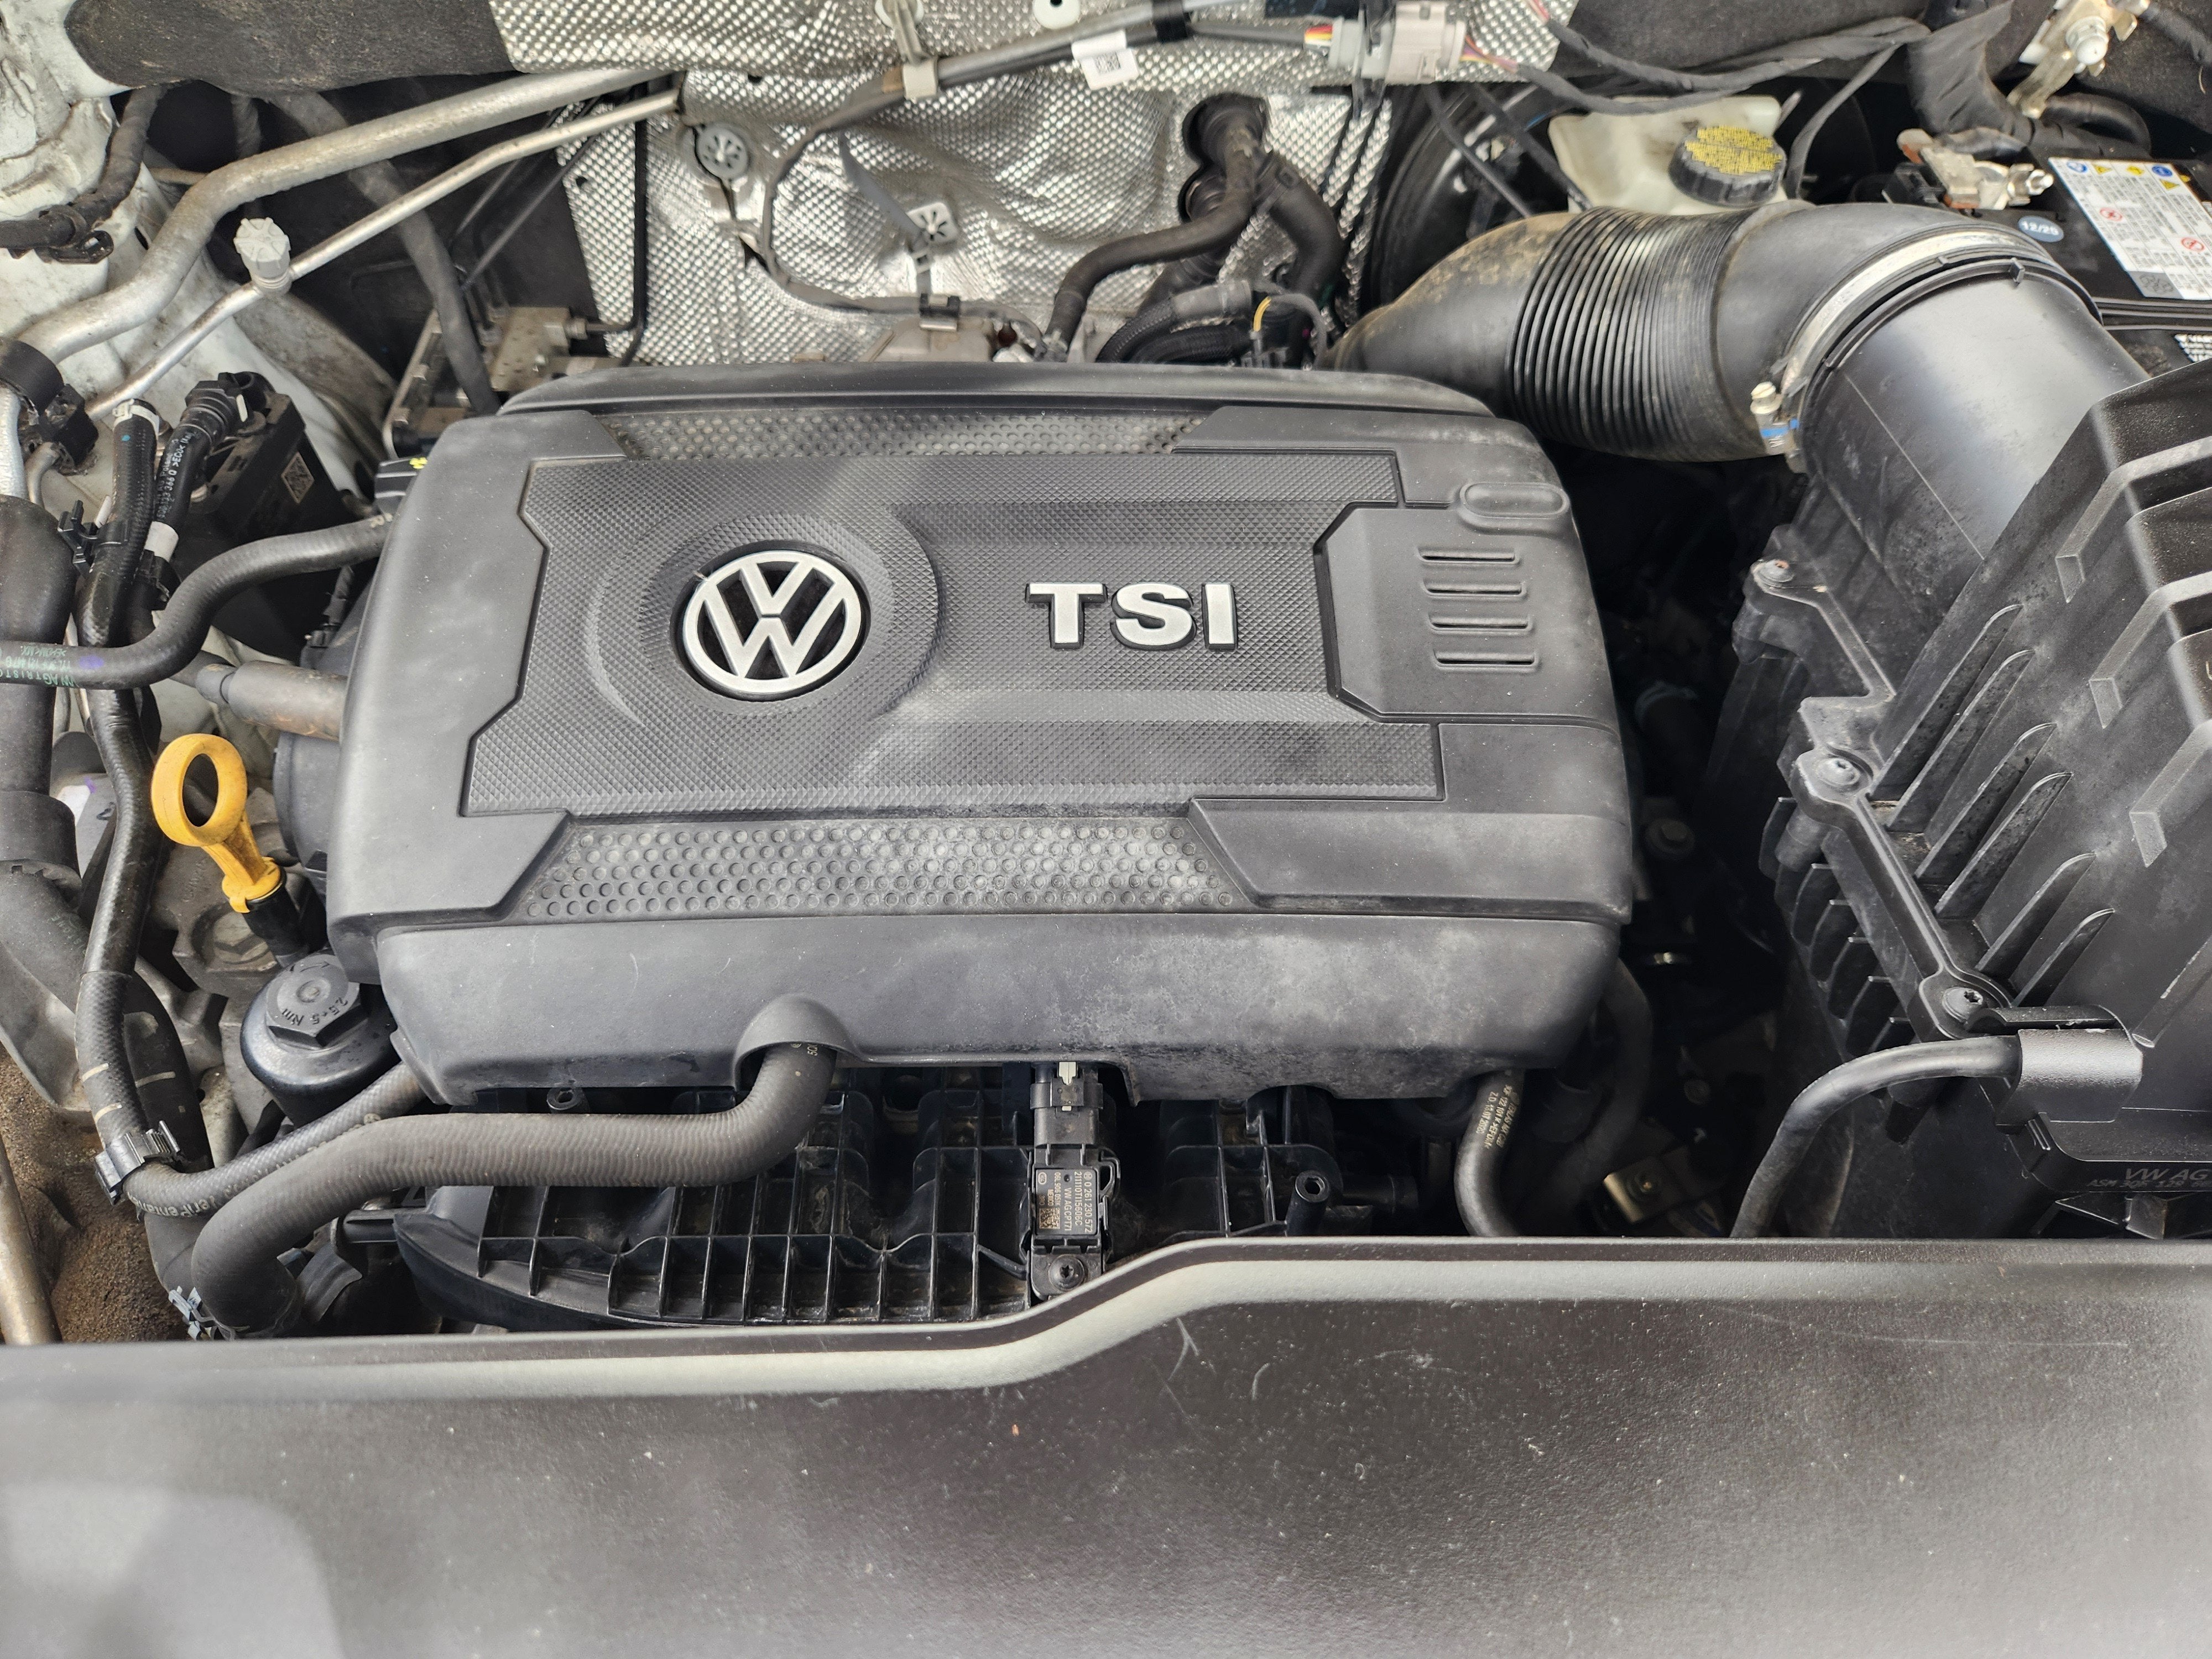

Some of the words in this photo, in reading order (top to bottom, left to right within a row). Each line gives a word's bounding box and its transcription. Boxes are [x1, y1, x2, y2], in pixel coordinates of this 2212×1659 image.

[682, 550, 862, 695] VW
[1026, 583, 1239, 650] TSI
[41, 672, 58, 685] AG
[1498, 1095, 1508, 1107] 122
[1495, 1107, 1504, 1117] 101
[2126, 1168, 2170, 1181] VW
[2169, 1168, 2212, 1181] AG
[1064, 1187, 1072, 1199] VW
[1074, 1171, 1083, 1226] 211110T115606C
[1084, 1188, 1092, 1201] 261
[1064, 1200, 1072, 1211] AG
[1084, 1203, 1093, 1217] 230
[1084, 1218, 1093, 1233] 572
